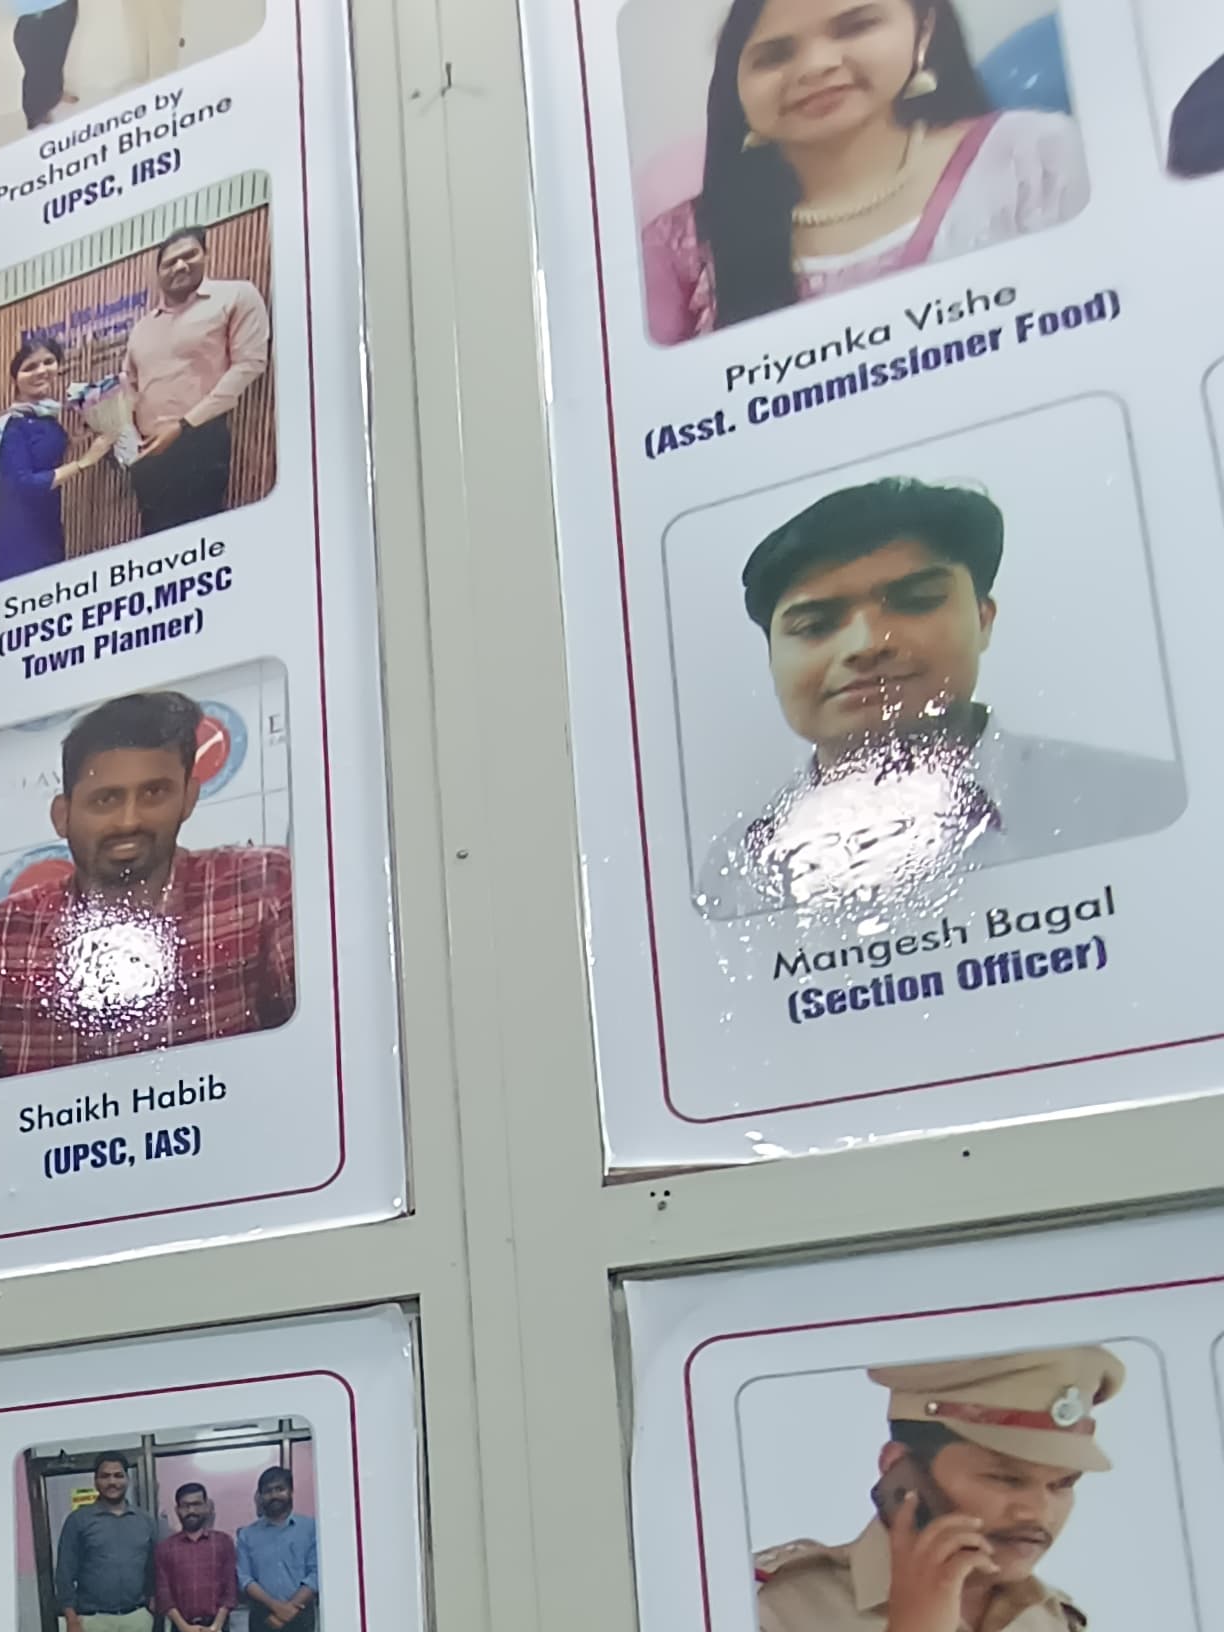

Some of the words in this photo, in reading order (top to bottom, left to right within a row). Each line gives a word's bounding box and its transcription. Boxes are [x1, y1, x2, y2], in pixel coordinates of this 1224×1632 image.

[38, 104, 147, 160] Guidance
[155, 88, 184, 112] by
[118, 97, 233, 155] Bhojane
[42, 174, 124, 224] (UPSC,
[131, 148, 182, 188] IRS)
[644, 409, 738, 460] (Asst.
[747, 325, 1005, 427] Commissioner
[1014, 288, 1122, 345] Food)
[724, 323, 893, 392] Priyanka
[904, 285, 1018, 332] Vishe
[4, 571, 98, 619] Snehal
[109, 537, 226, 588] Bhavale
[81, 566, 233, 631] EPFO,MPSC
[22, 644, 85, 680] Town
[93, 608, 204, 660] Planner)
[772, 917, 969, 980] Mangesh
[985, 884, 1117, 939] Bagal
[787, 970, 944, 1025] (Section
[957, 936, 1108, 991] Officer)
[18, 1096, 120, 1134] Shaikh
[131, 1073, 227, 1113] Habib
[43, 1138, 136, 1179] (UPSC,
[144, 1124, 201, 1162] IAS)
